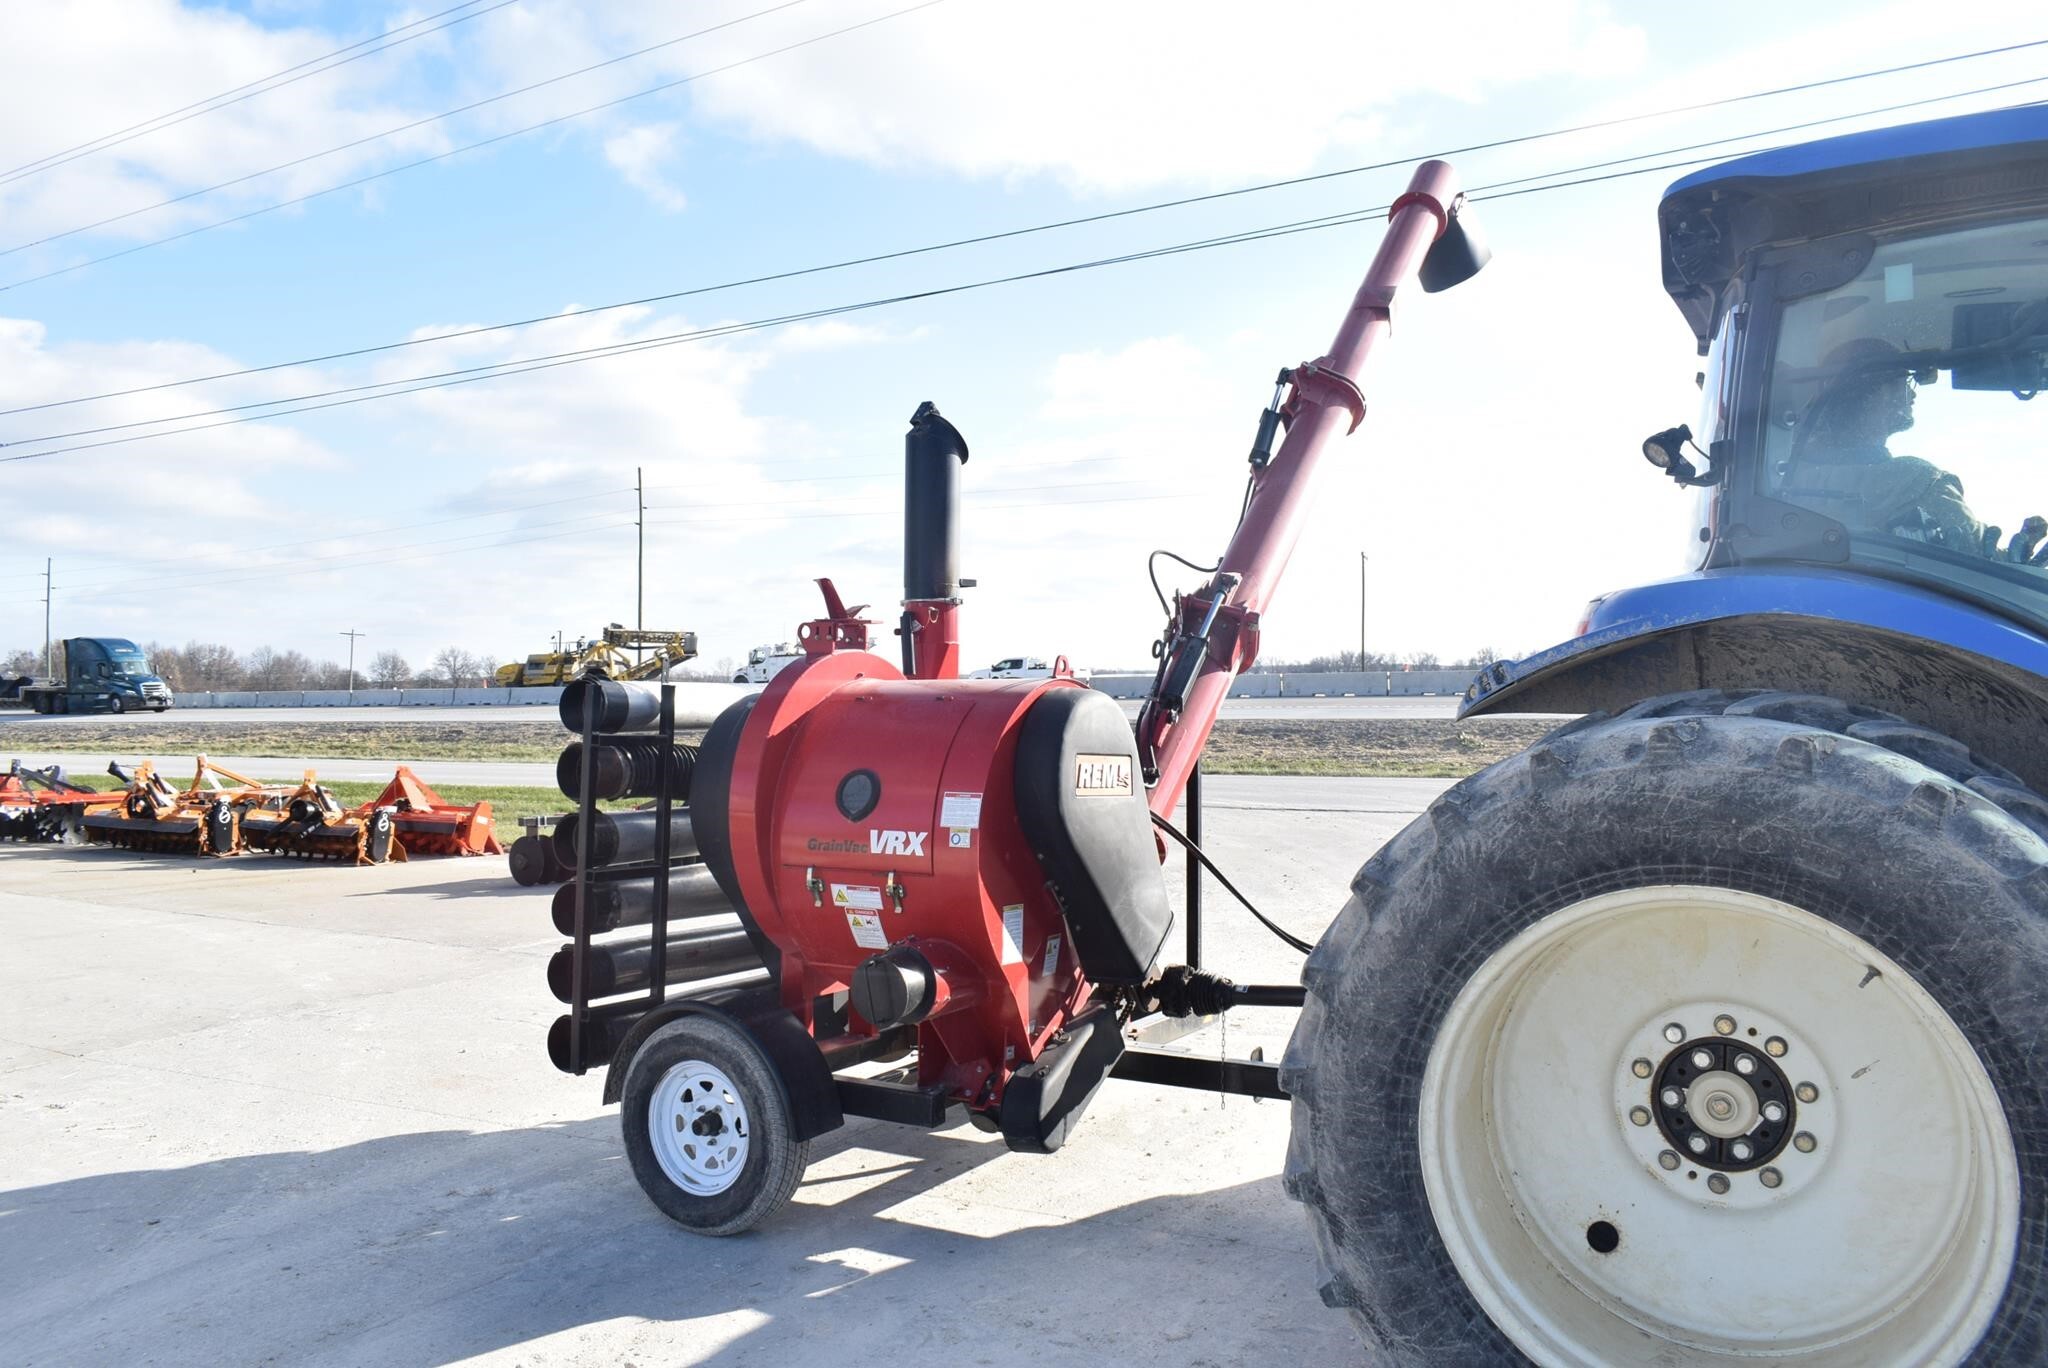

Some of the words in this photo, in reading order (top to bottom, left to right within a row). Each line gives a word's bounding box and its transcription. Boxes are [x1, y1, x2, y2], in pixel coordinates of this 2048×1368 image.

[1077, 763, 1118, 788] REM
[807, 838, 868, 853] GrainVac
[869, 829, 928, 856] VRX
